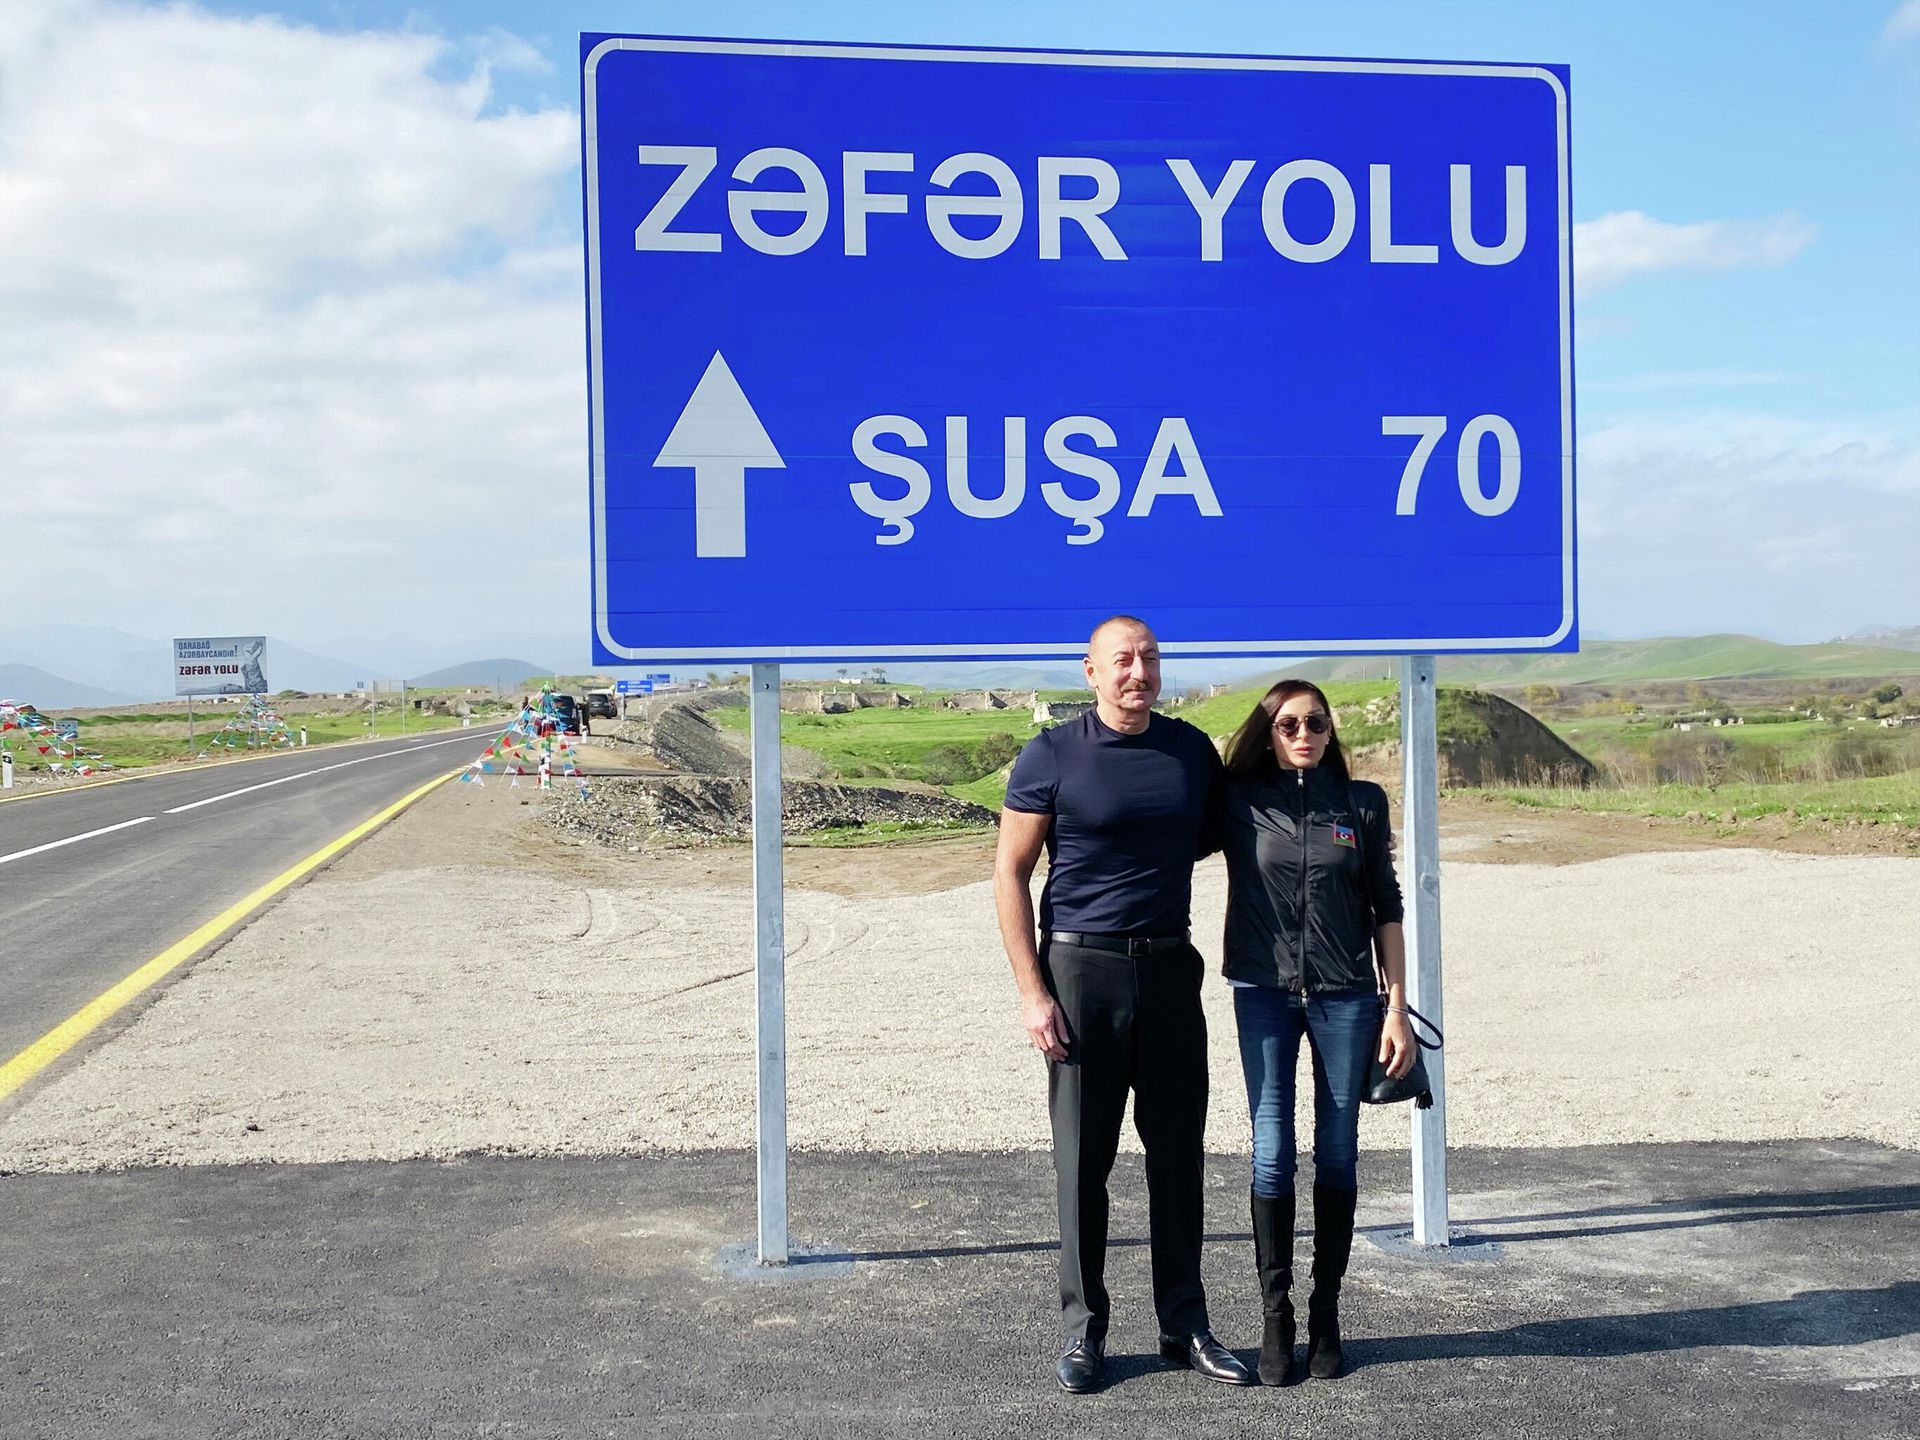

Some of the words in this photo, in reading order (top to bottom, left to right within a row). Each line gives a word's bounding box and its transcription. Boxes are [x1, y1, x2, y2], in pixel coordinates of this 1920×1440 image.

[635, 146, 1128, 260] ZƏFƏR
[1166, 159, 1526, 265] YOLU
[849, 415, 1223, 545] ŞUŞA
[1382, 415, 1520, 517] 70
[179, 665, 211, 675] ZƏFƏR
[213, 664, 239, 674] YOLU
